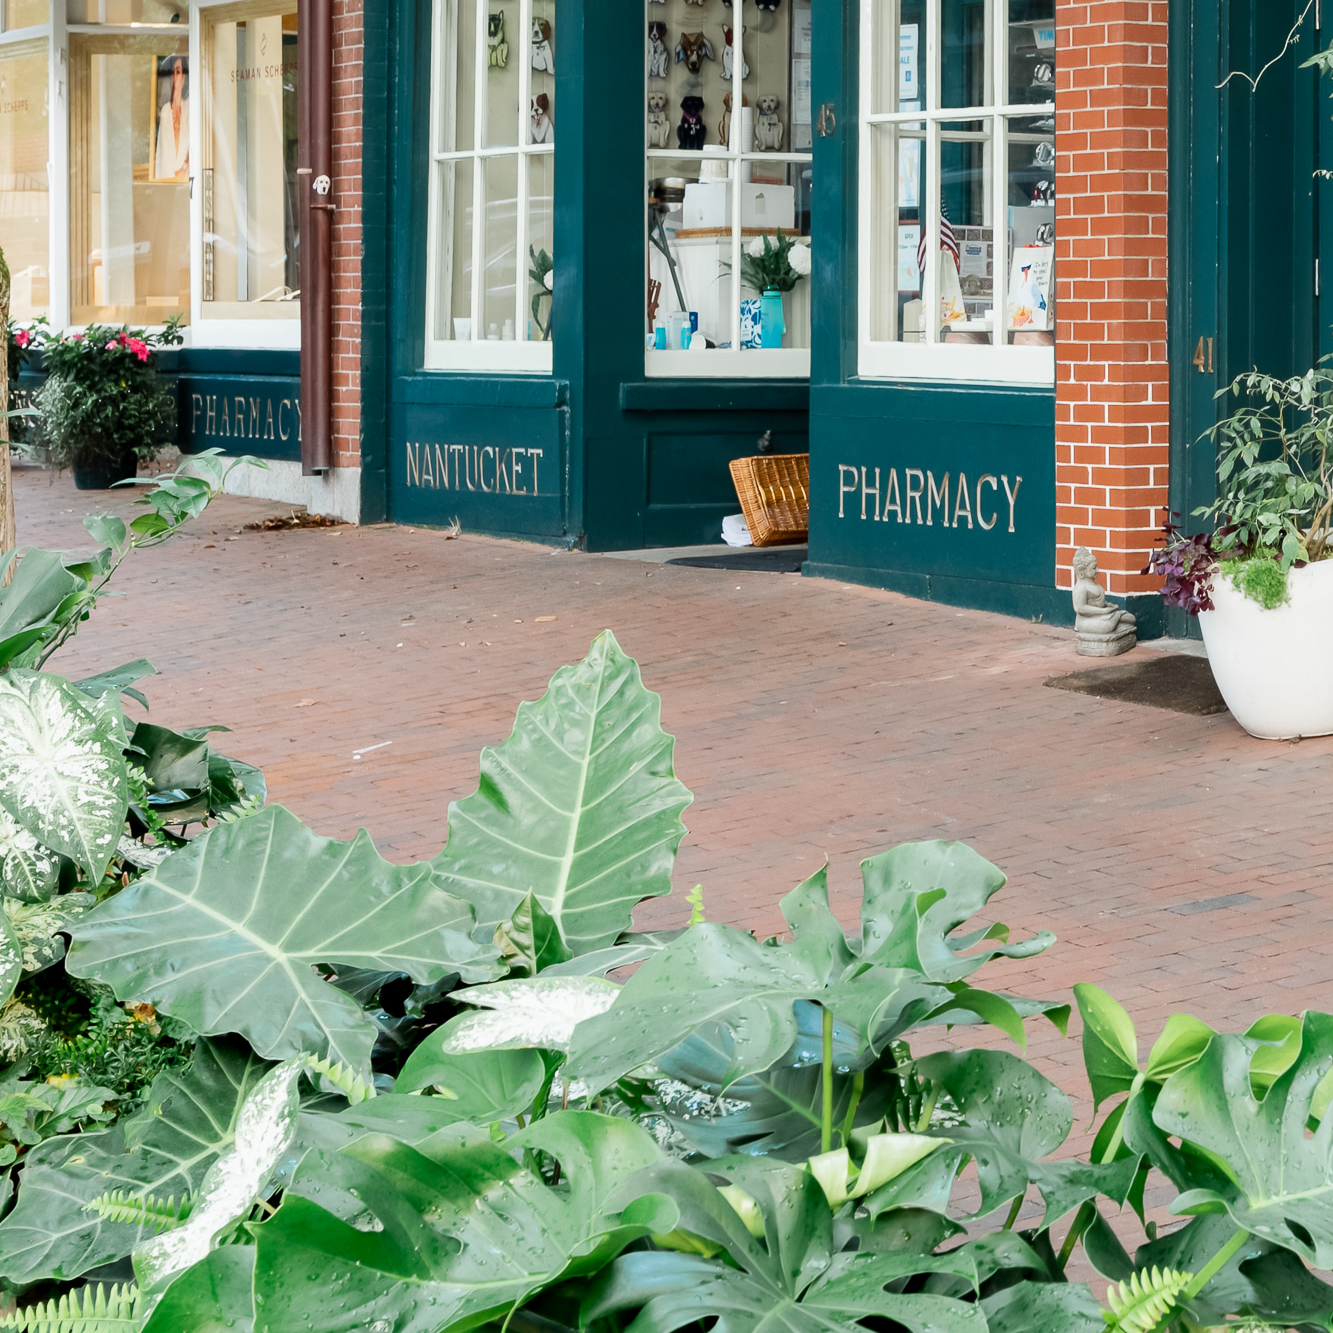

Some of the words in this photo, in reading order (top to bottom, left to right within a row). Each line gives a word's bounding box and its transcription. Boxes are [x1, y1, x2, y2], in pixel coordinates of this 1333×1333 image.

[230, 66, 261, 83] SEAMAN
[816, 103, 836, 138] 45
[1192, 335, 1214, 374] 41
[406, 442, 544, 497] NANTUCKET
[837, 463, 1024, 534] PHARMACY
